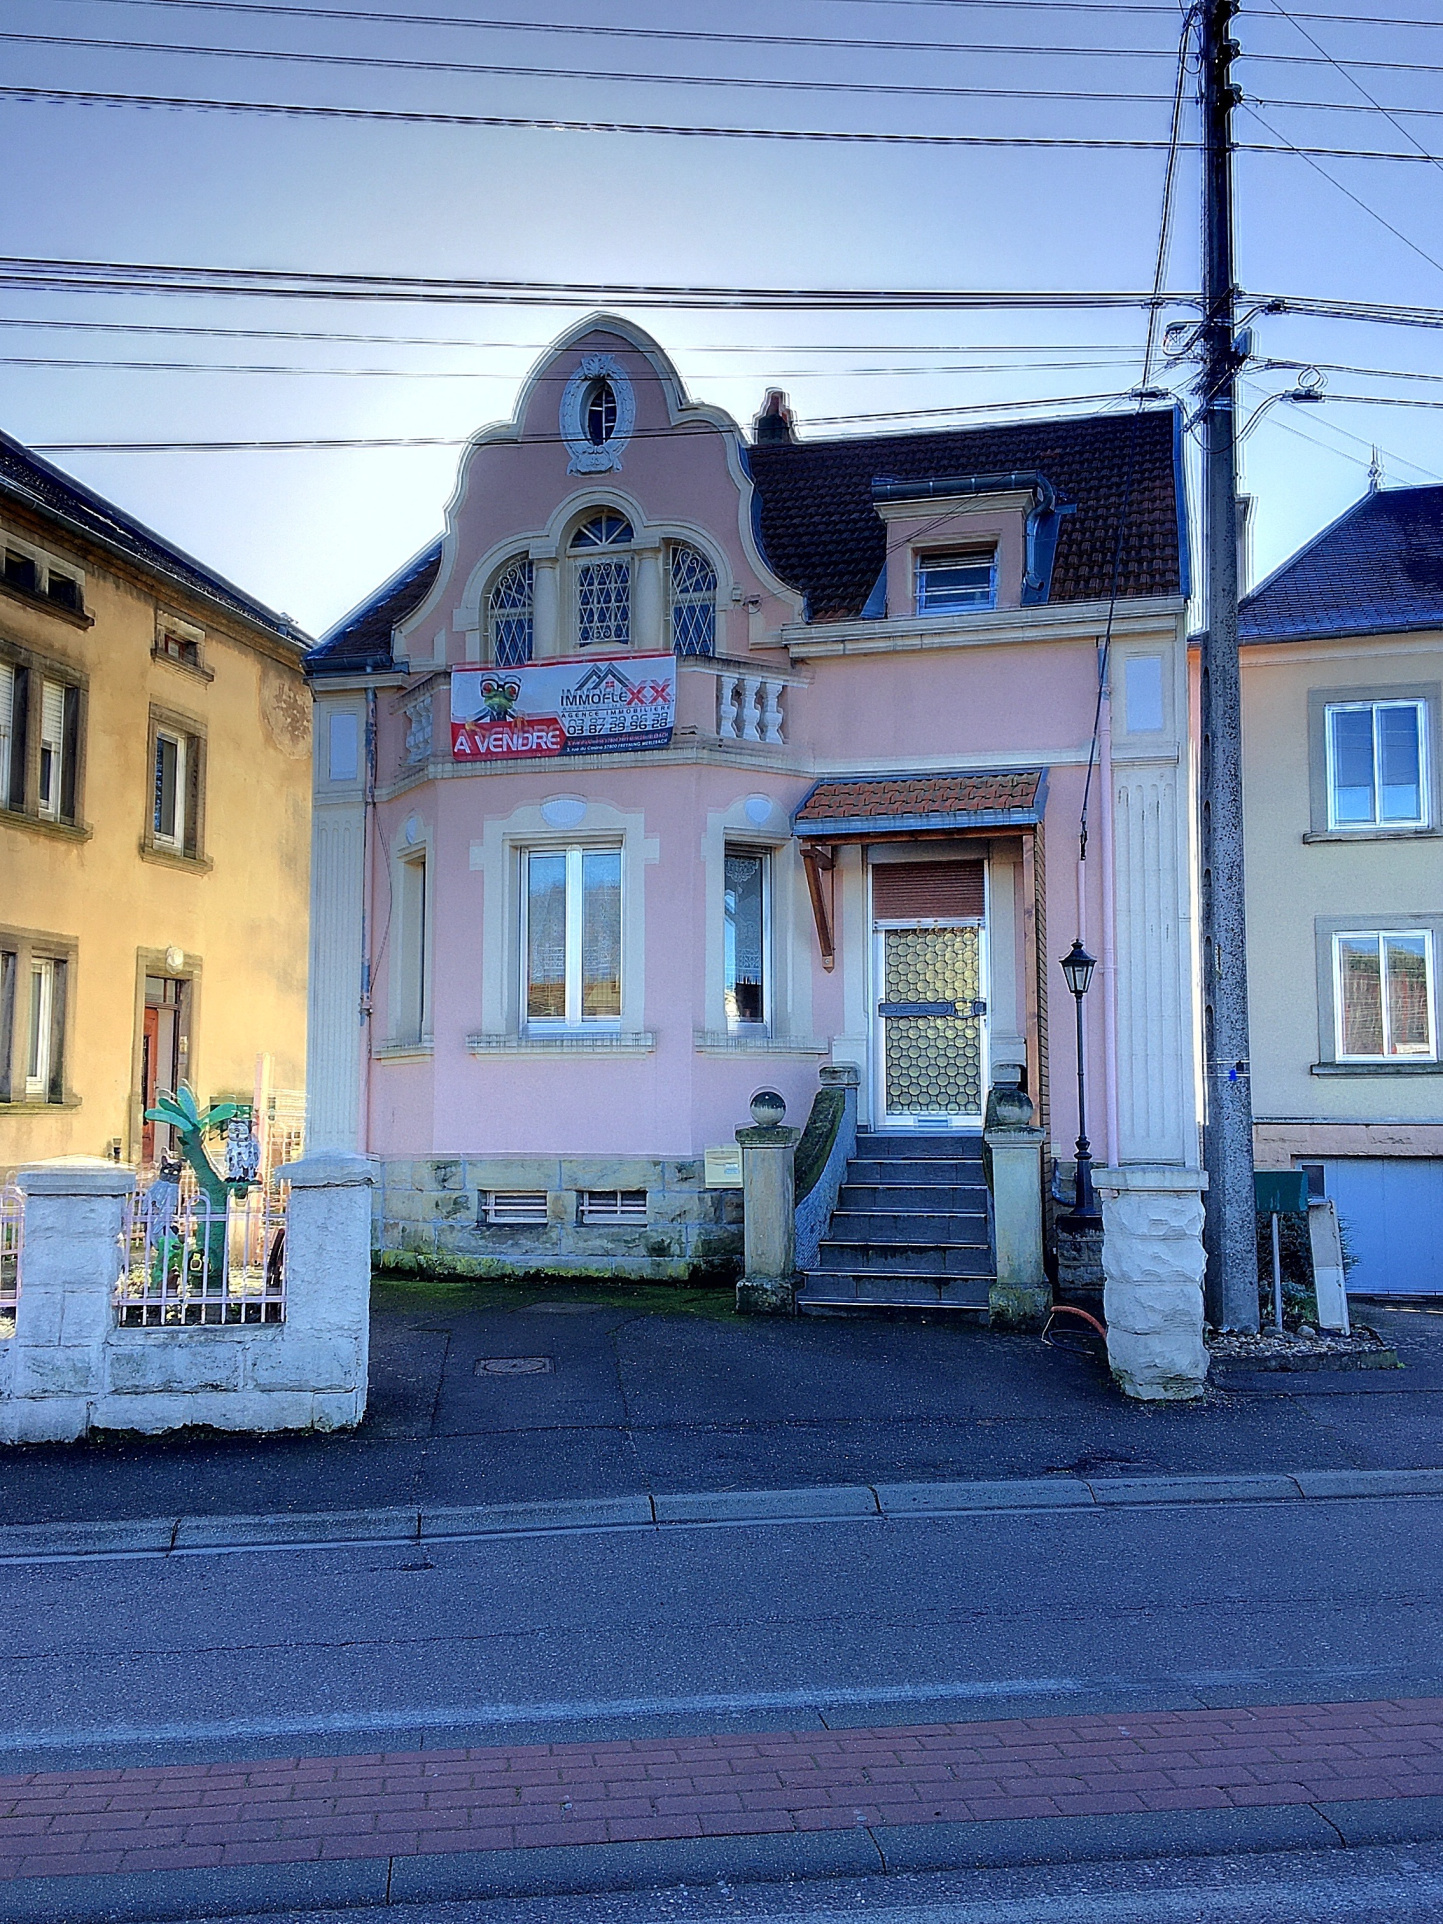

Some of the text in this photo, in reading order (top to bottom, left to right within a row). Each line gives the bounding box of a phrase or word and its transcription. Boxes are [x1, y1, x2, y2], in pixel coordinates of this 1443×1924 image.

[560, 683, 670, 707] IMMOFLEXX
[561, 711, 600, 719] AGENCE
[567, 717, 668, 735] 03 87 29 96 28
[453, 730, 560, 754] A VENDRE
